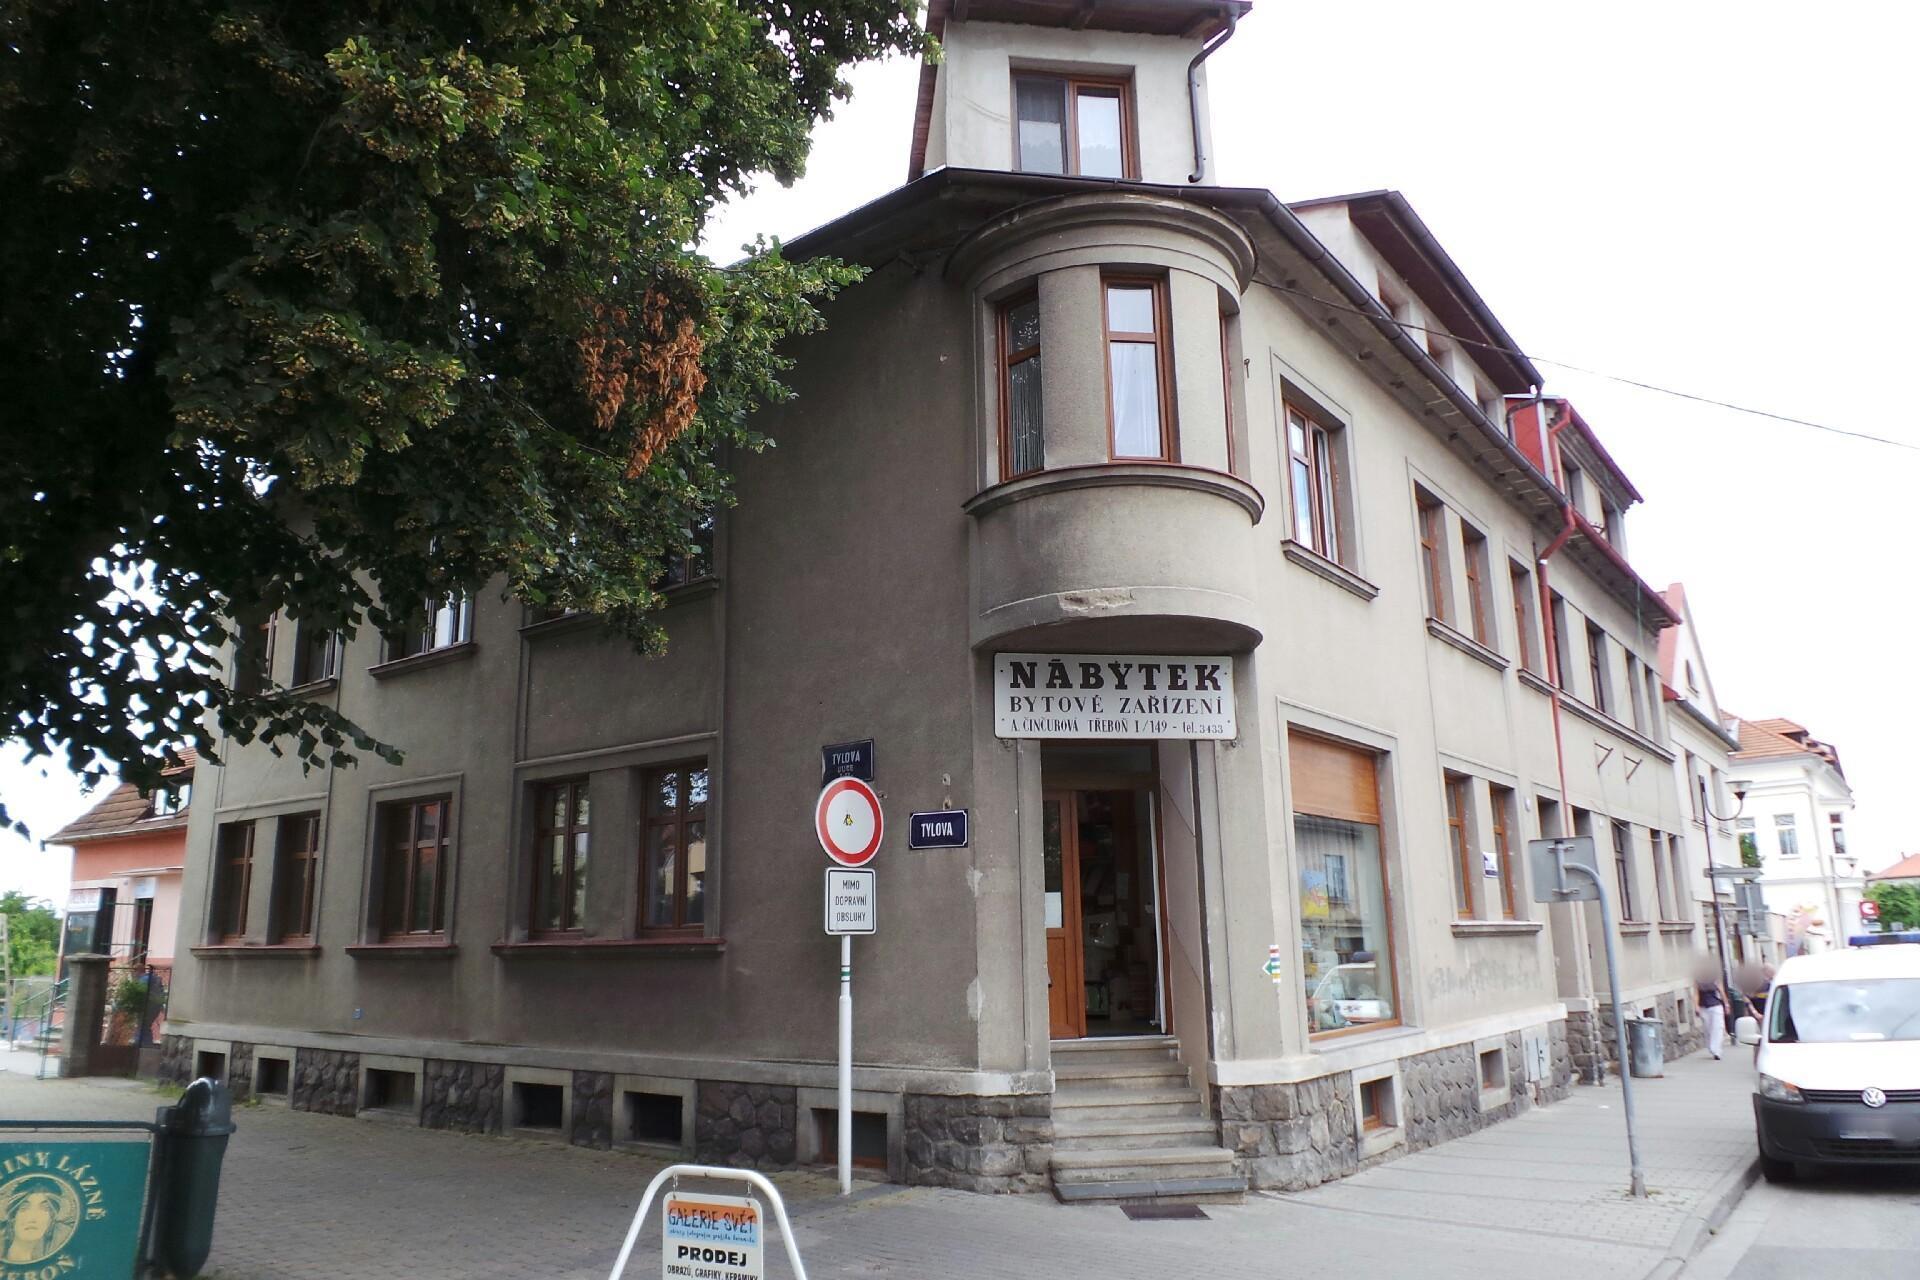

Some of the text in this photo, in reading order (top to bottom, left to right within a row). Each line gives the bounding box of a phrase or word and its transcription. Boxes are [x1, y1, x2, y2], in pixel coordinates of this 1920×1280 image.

[1009, 694, 1222, 714] BYTOVÉ ZAŘÍZENÍ
[1088, 717, 1128, 733] TŘEBOŇ
[832, 750, 861, 766] TYLOVA
[920, 821, 953, 838] TYLOVA
[842, 879, 860, 890] MIMO
[836, 911, 866, 922] OBSLUHY
[668, 1207, 719, 1231] GALERIE
[677, 1245, 747, 1267] PRODEJ
